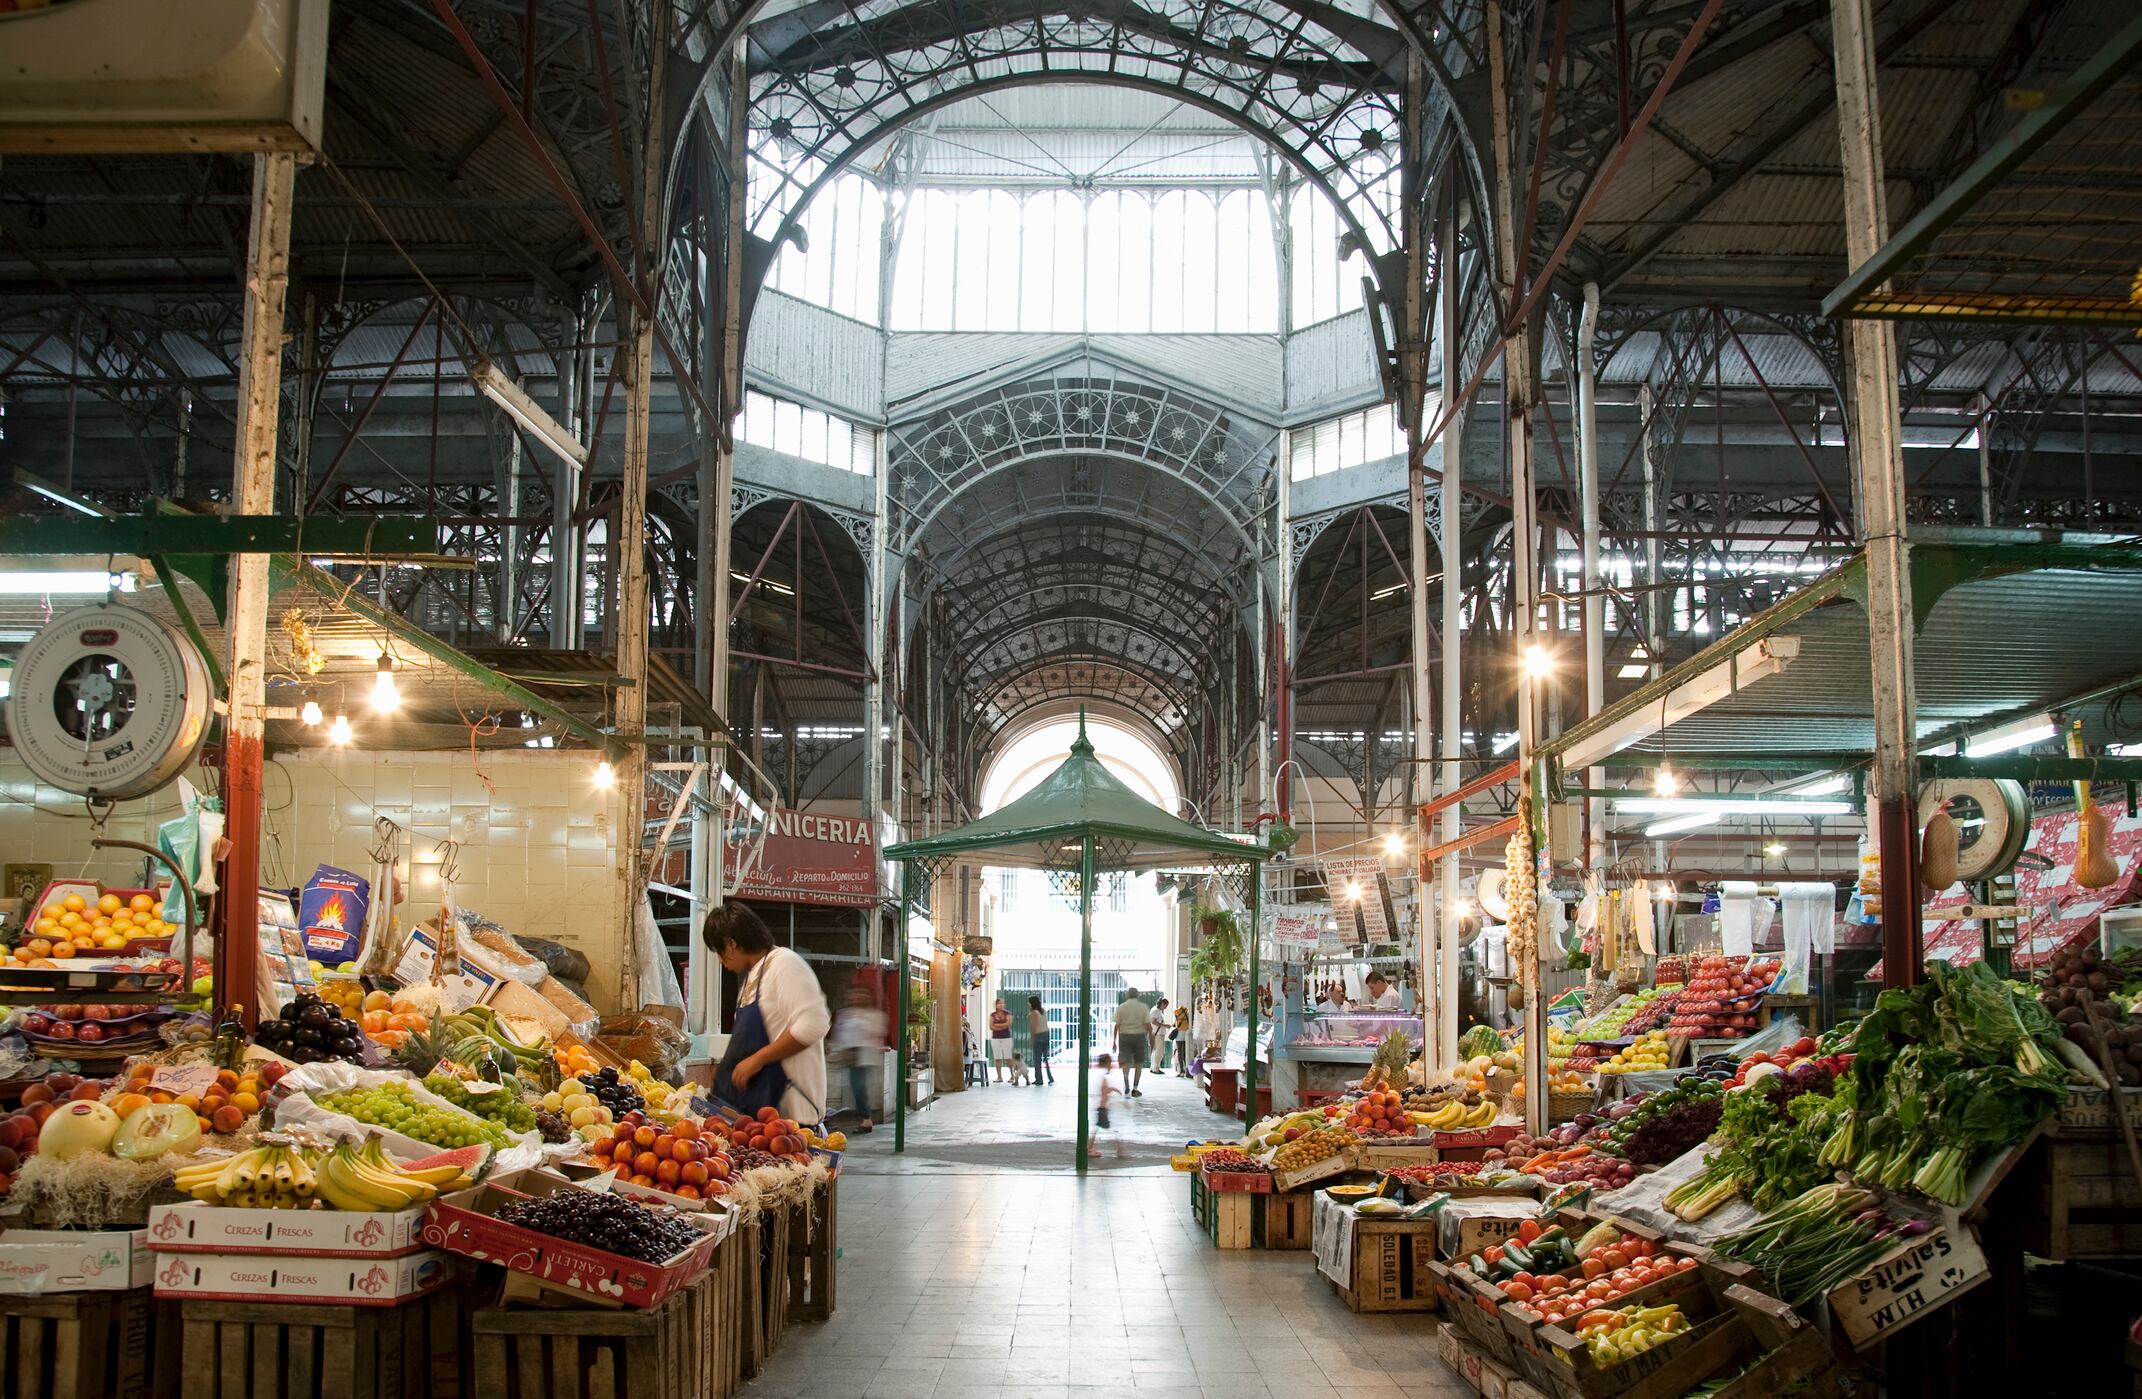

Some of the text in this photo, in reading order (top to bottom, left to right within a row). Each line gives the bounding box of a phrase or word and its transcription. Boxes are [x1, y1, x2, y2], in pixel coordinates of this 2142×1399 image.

[1326, 861, 1345, 870] LISTA
[791, 871, 826, 883] REPARTO
[830, 870, 869, 882] DOMICILIO
[224, 1224, 313, 1237] CEREZAS FRESCAS
[550, 1252, 606, 1277] CARLETI
[1383, 1236, 1396, 1282] SOLEDAD
[230, 1271, 318, 1285] CEREZAS FRESCAS
